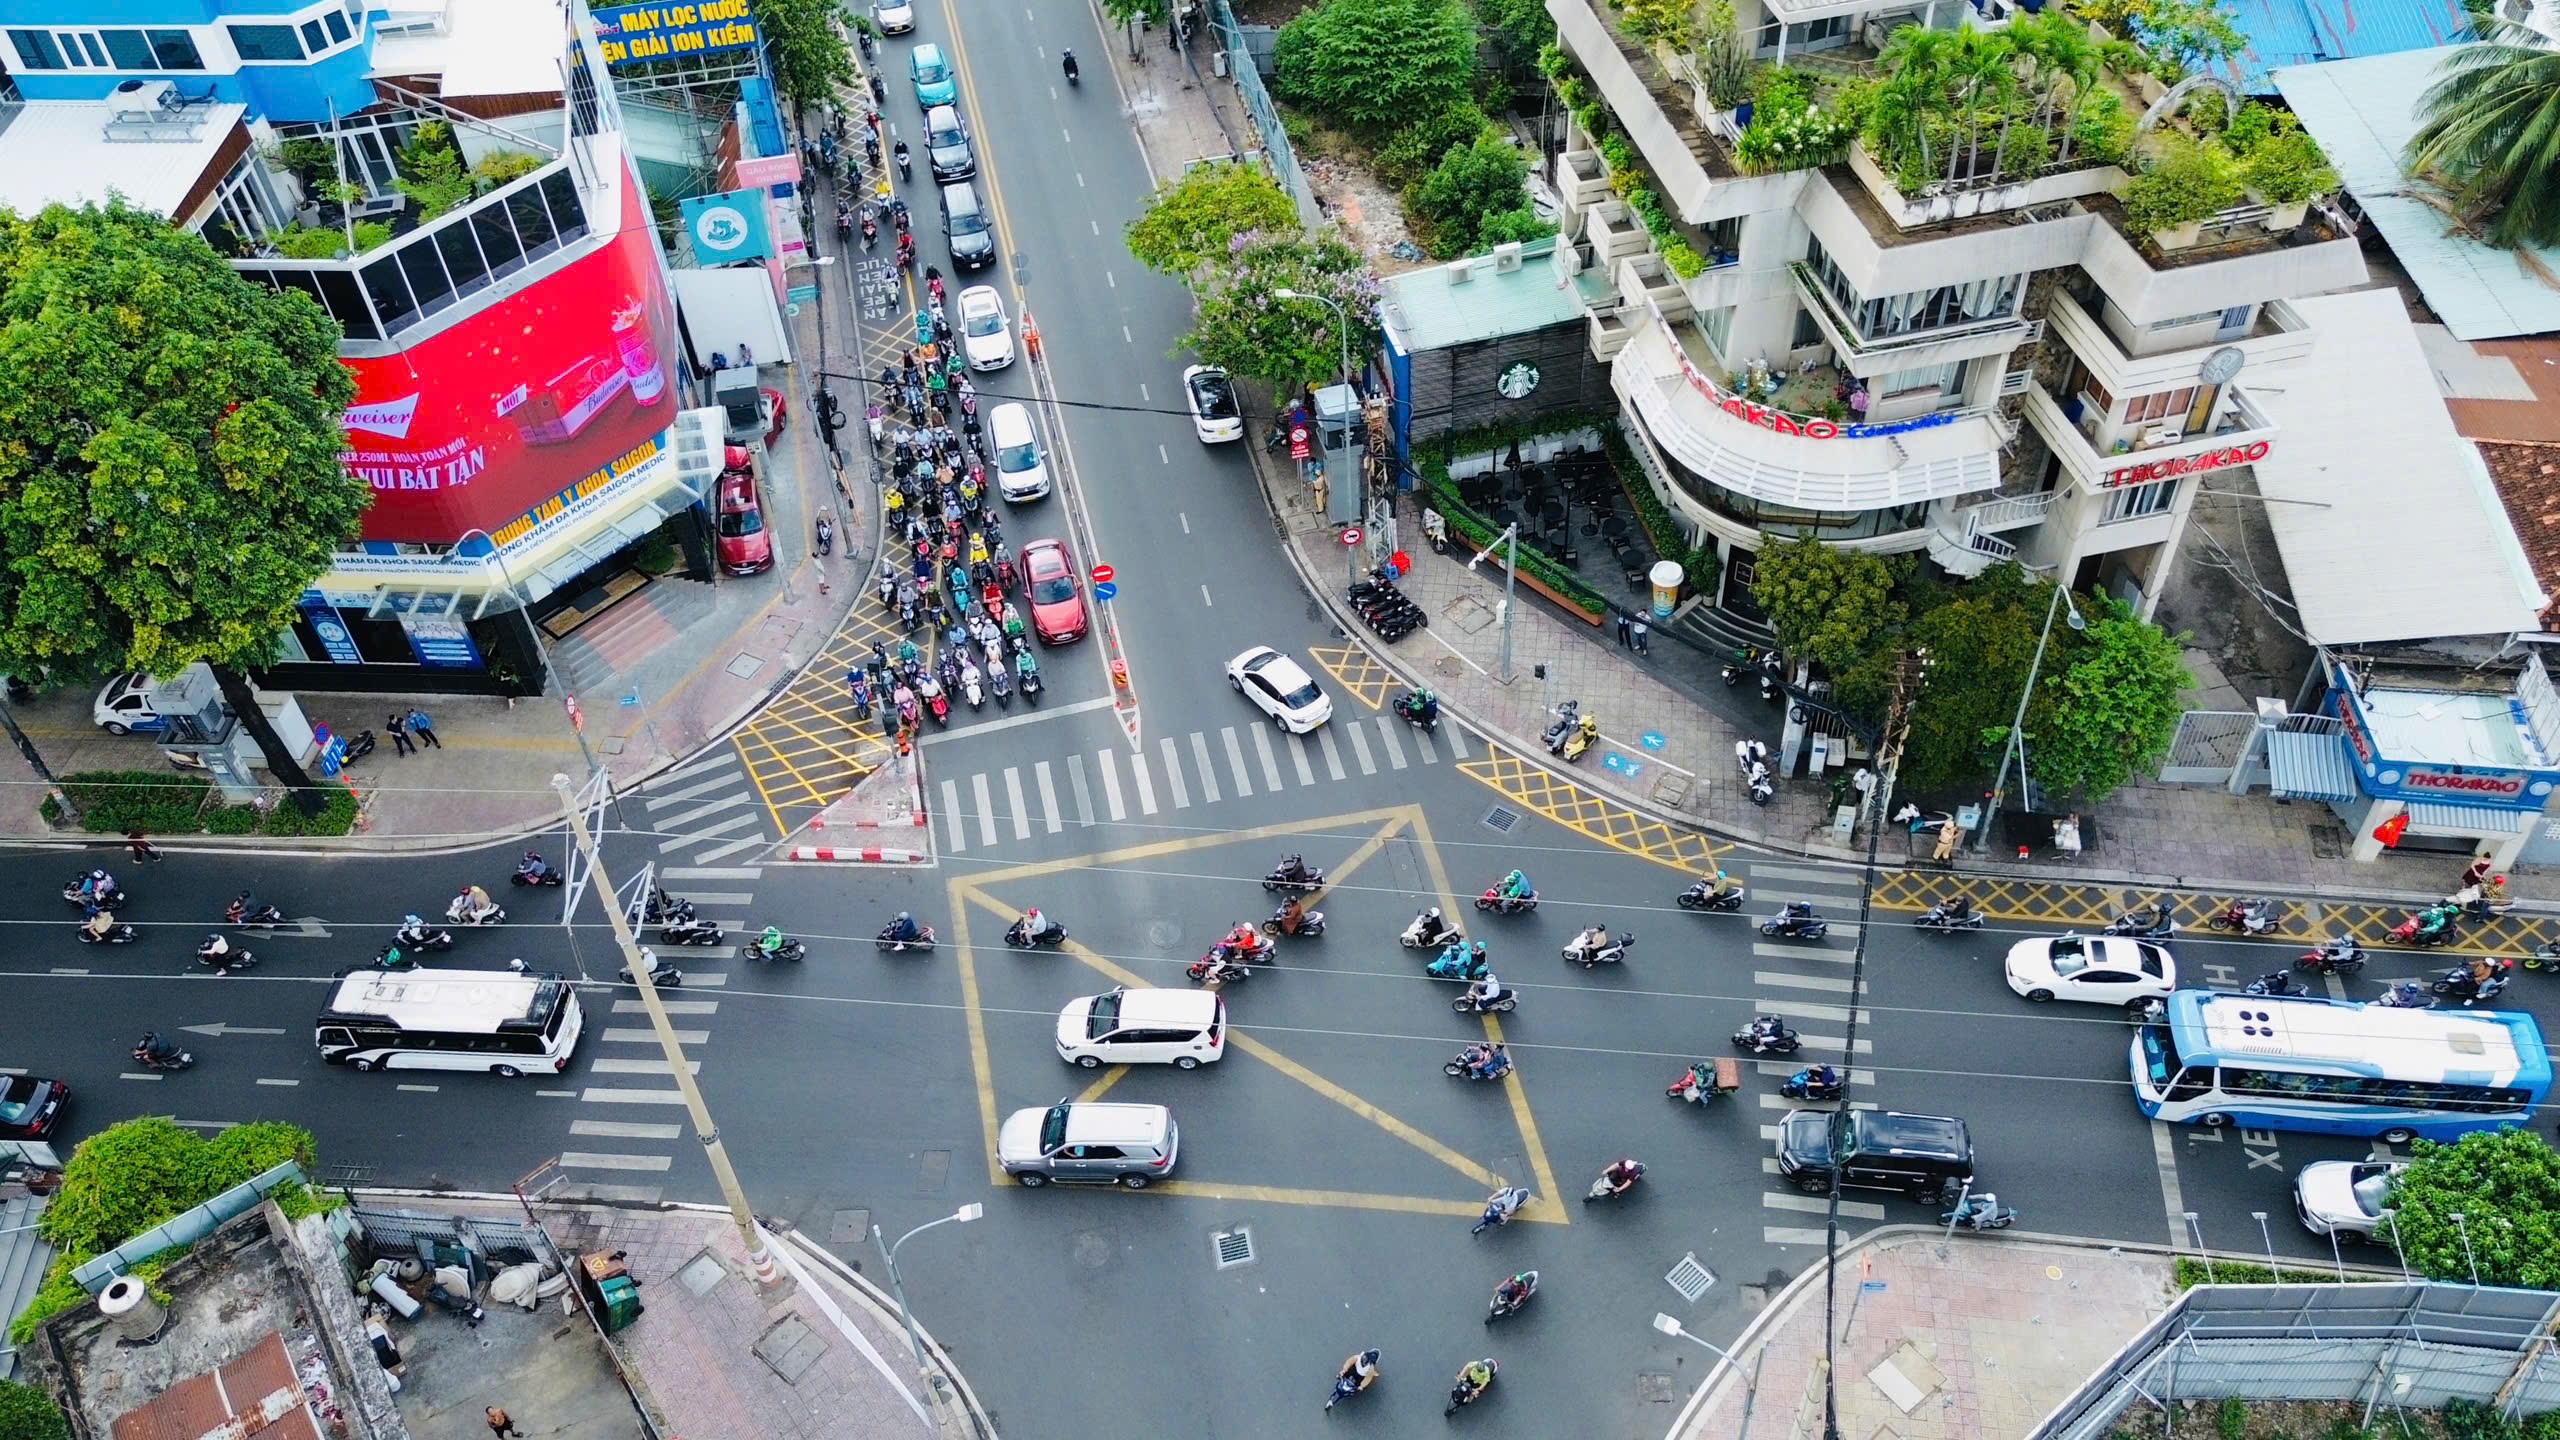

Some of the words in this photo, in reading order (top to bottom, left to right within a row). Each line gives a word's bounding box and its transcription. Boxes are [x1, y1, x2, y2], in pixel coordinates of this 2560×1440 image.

[619, 10, 661, 33] MÁY
[662, 5, 698, 30] LỌC
[698, 0, 749, 23] NƯỚC
[630, 31, 669, 58] GIẢI
[672, 31, 705, 52] ION
[344, 409, 411, 424] weiser
[355, 467, 395, 490] VUI
[398, 461, 442, 490] BẤT
[444, 444, 485, 487] TẬN
[360, 452, 390, 463] 250ML
[2111, 440, 2270, 488] THORAKAO
[491, 514, 535, 549] TRUNG
[563, 488, 576, 504] Y
[574, 470, 611, 499] KHOA
[610, 439, 658, 475] SAIGON
[570, 496, 599, 519] KHOA
[599, 472, 636, 498] SAIGON
[636, 453, 667, 474] MEDIC
[382, 558, 410, 566] KHOA
[410, 558, 448, 567] SAIGO
[2407, 773, 2520, 794] THORAKAO
